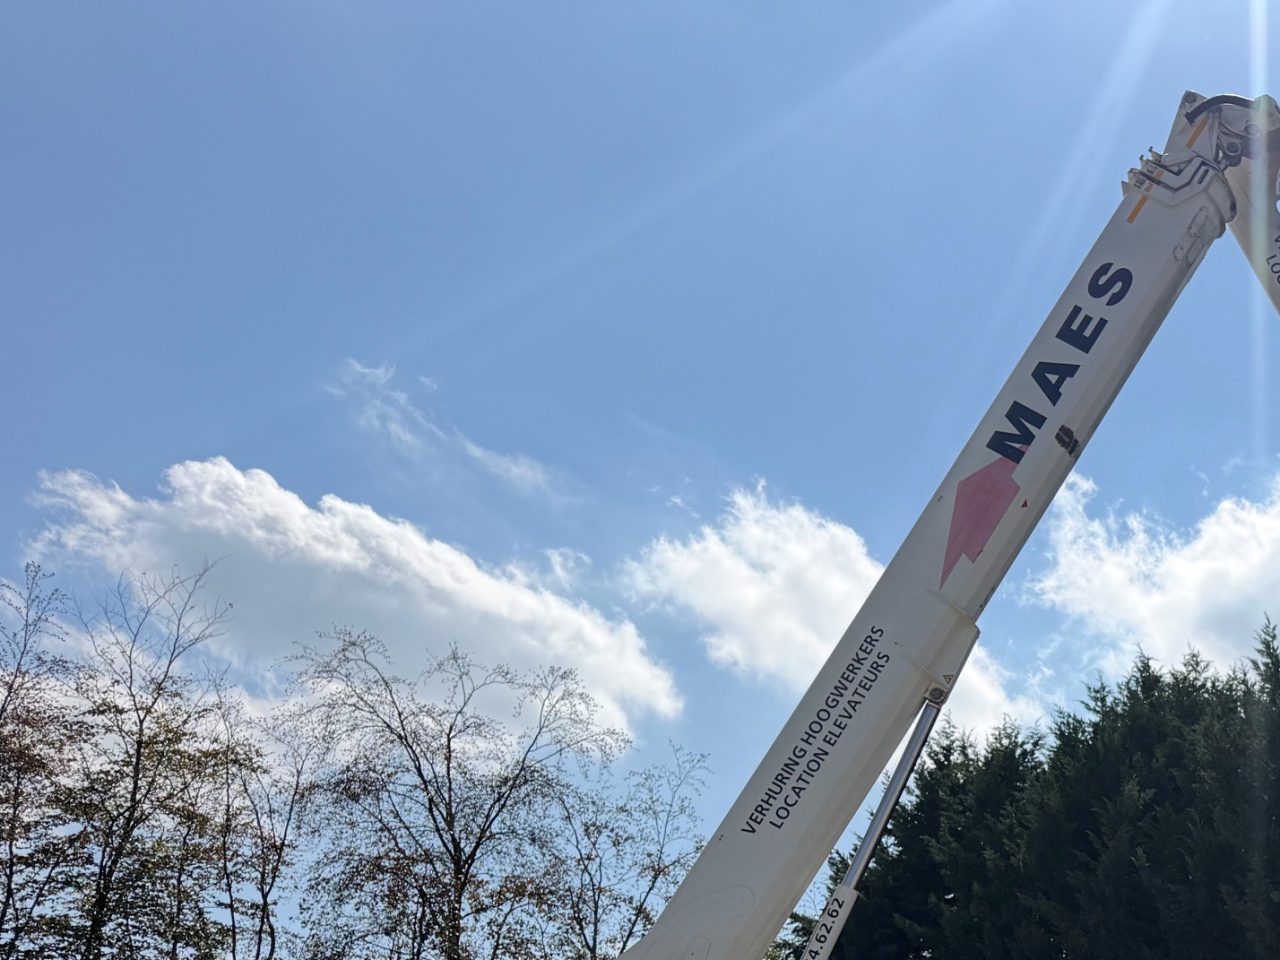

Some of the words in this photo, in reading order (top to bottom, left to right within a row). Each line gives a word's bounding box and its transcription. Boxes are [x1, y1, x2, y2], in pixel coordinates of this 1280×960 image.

[985, 262, 1134, 465] MAES
[741, 745, 808, 836] VERHURING
[800, 625, 885, 747] HOOGWERKERS
[769, 747, 830, 829] LOCATION
[822, 651, 891, 748] ELEVATEURS
